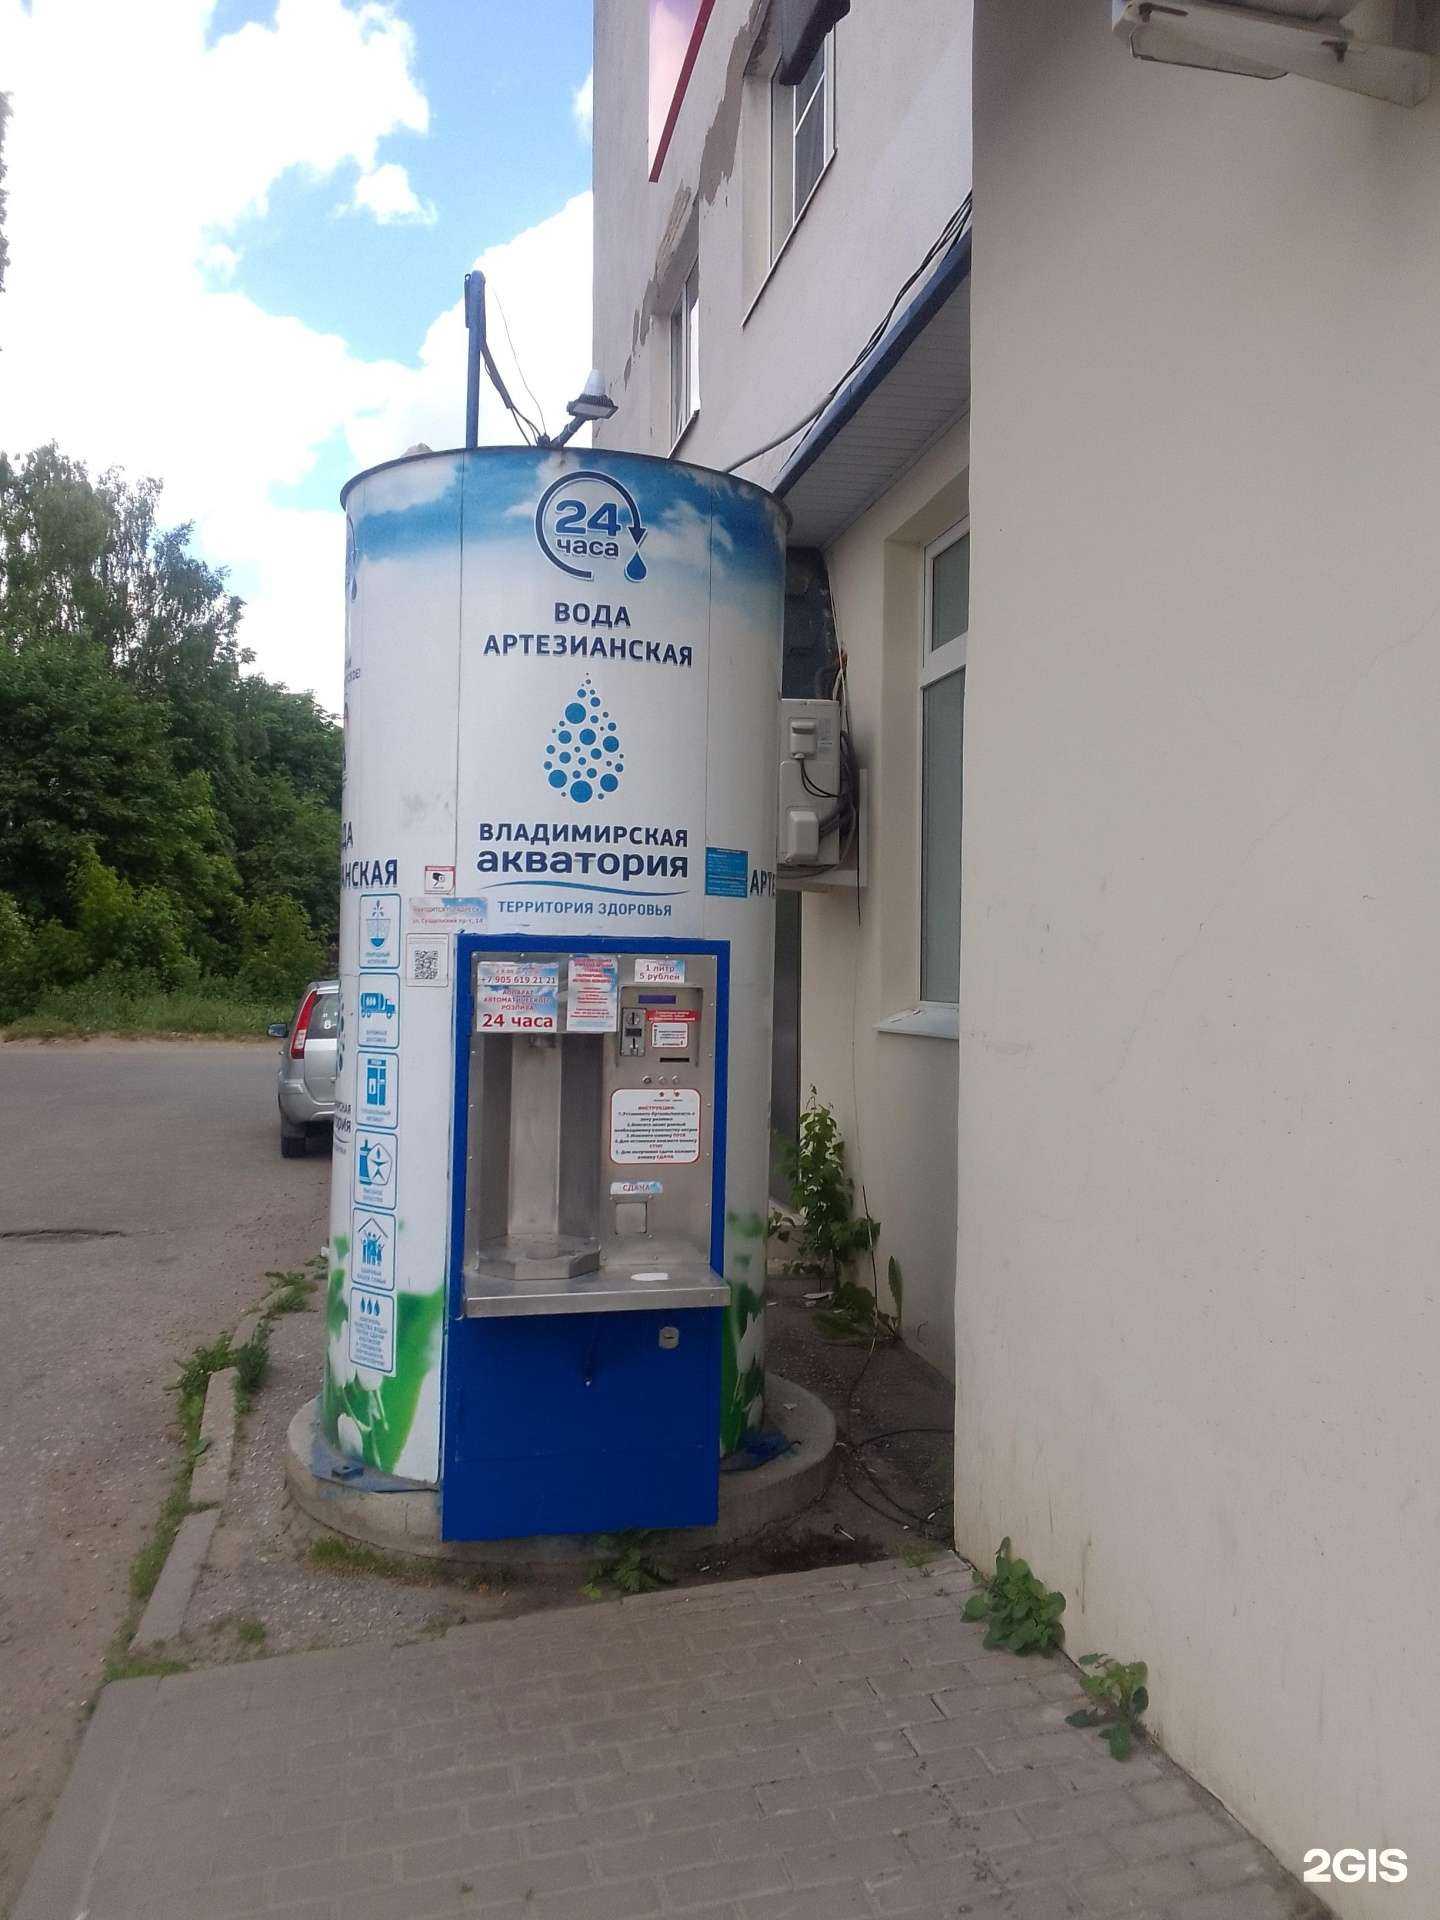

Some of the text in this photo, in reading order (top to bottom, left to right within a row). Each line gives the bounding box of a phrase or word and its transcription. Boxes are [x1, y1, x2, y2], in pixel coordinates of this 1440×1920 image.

[555, 499, 621, 537] 24
[556, 539, 619, 557] часа
[554, 602, 632, 628] ВОДА
[483, 634, 693, 667] АРТЕЗИАНСКАЯ
[479, 823, 688, 848] ВЛАДИМИРСКАЯ
[476, 850, 689, 881] акватория
[497, 901, 672, 916] ТЕРРИТОРИЯ ЗДОРОВЬЯ
[495, 976, 512, 984] 905
[513, 976, 531, 984] 619
[533, 976, 543, 984] 21
[545, 976, 556, 984] 21
[639, 972, 645, 980] 5
[482, 1013, 505, 1028] 24
[511, 1016, 554, 1028] часа
[622, 1184, 650, 1192] СДАЧА
